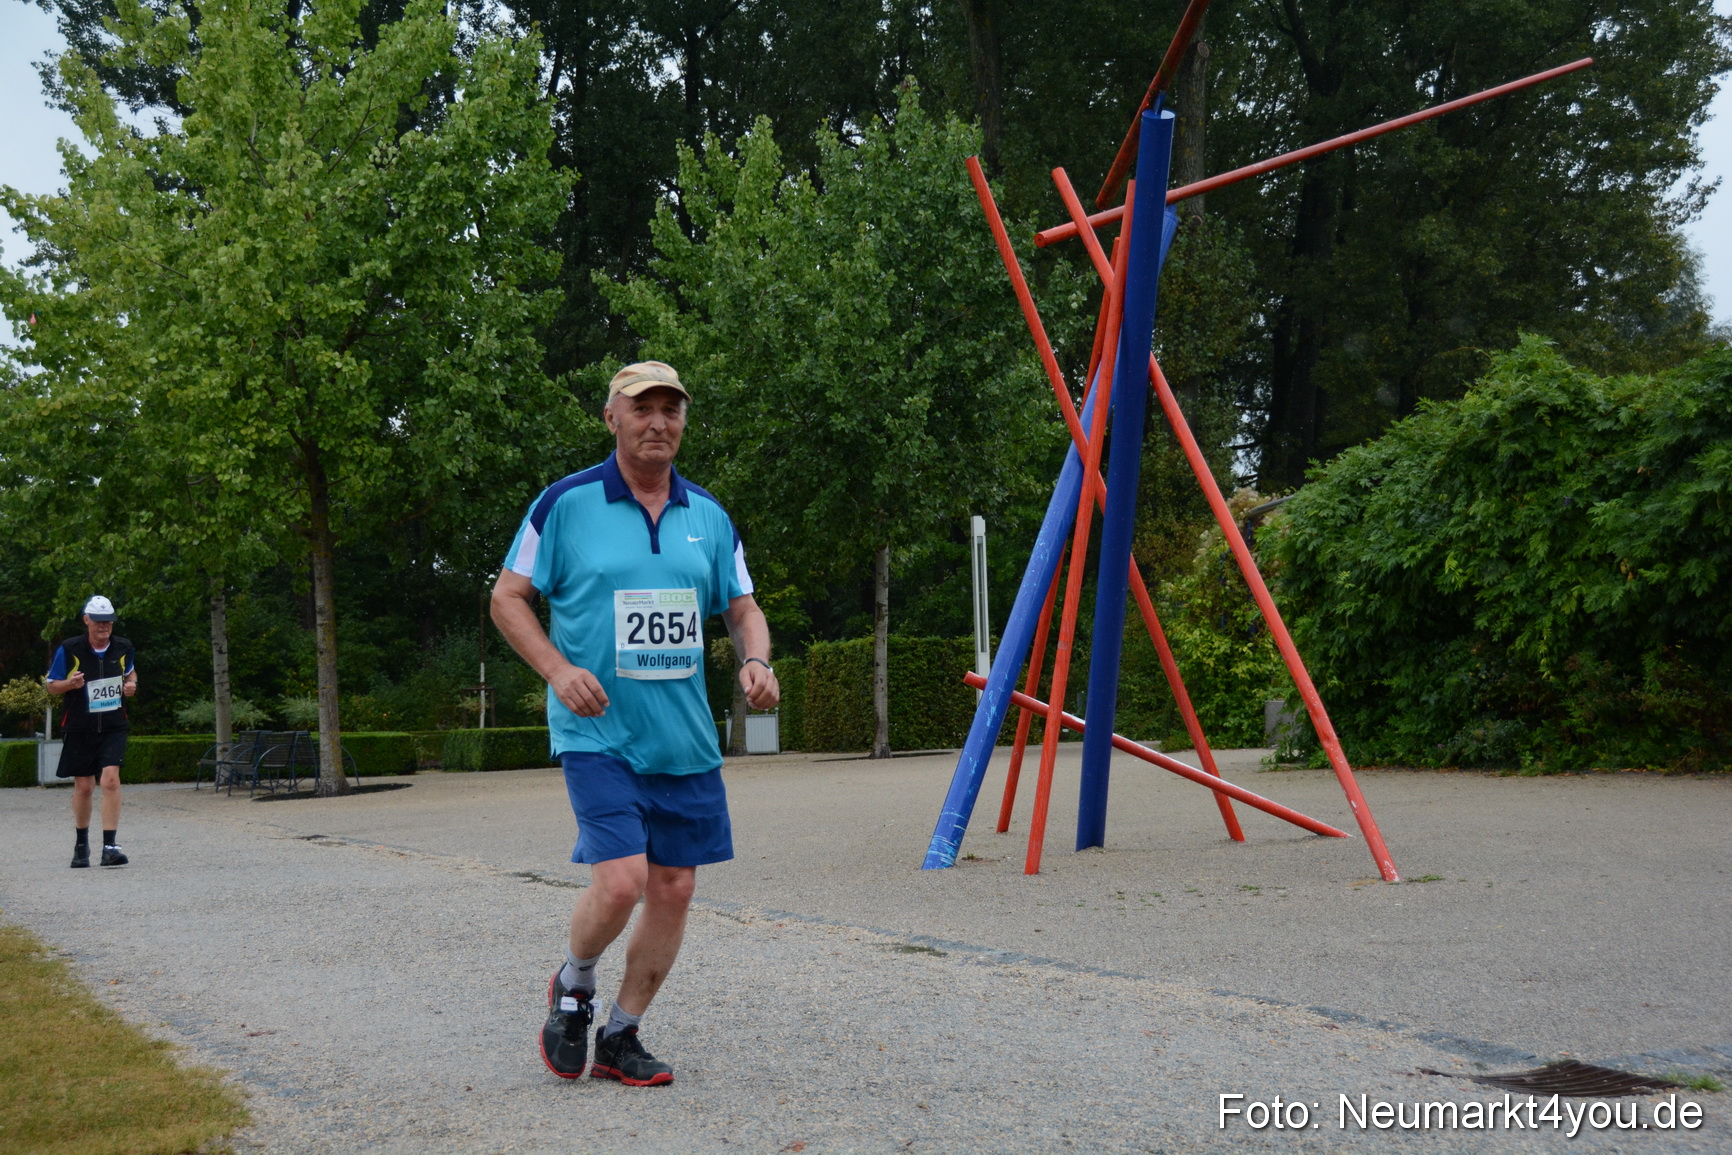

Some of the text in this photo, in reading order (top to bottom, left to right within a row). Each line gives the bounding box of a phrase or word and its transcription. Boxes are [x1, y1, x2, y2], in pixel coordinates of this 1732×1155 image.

[627, 611, 697, 645] 2654
[637, 654, 692, 669] Wolfgang
[93, 684, 122, 700] 2464
